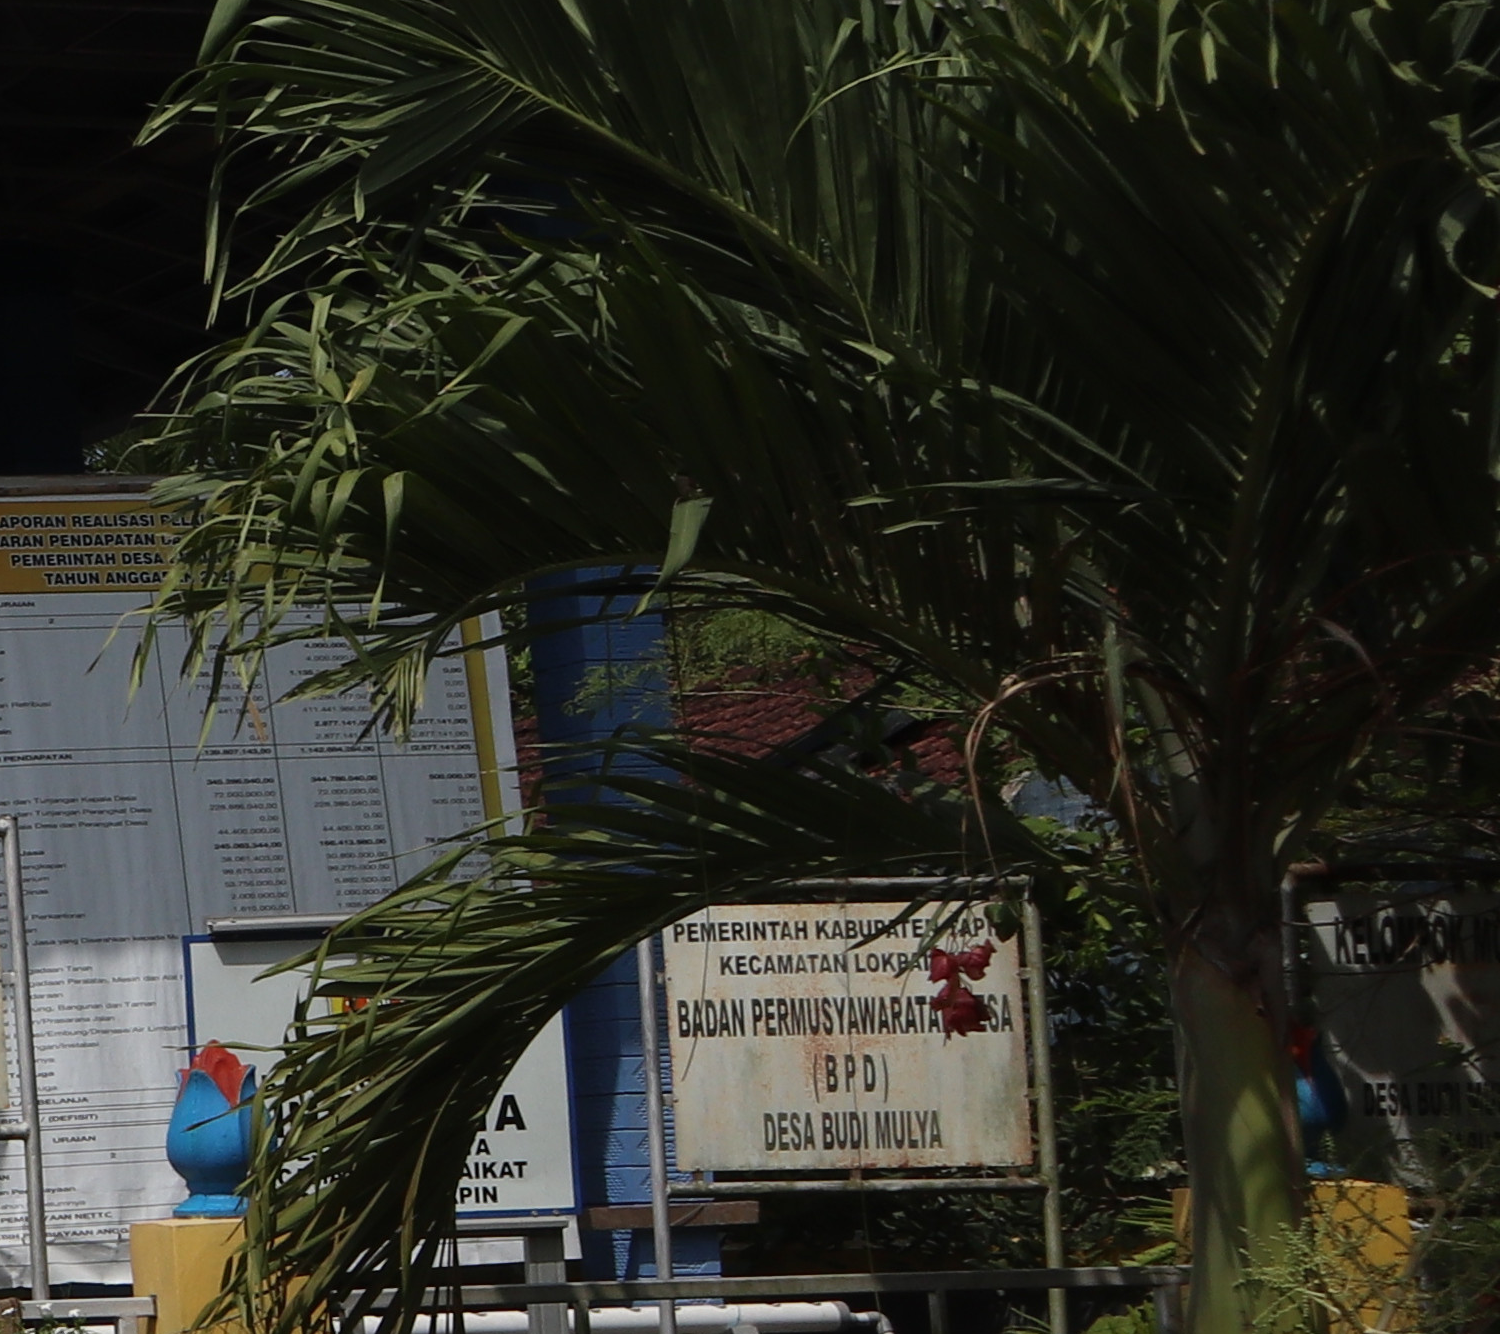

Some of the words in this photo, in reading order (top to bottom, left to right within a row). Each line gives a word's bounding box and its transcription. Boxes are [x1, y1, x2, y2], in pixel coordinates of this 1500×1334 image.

[72, 514, 155, 528] REALISASI
[50, 533, 155, 547] PENDAPATAN
[11, 553, 116, 567] PEMERINTAH
[122, 552, 163, 565] DESA
[44, 572, 99, 585] TAHUN
[673, 921, 808, 943] PEMERINTAH
[720, 954, 847, 976] KECAMATAN
[677, 999, 745, 1038] BADAN
[753, 996, 942, 1038] PERMUSYAWARATA
[764, 1112, 815, 1151] DESA
[822, 1112, 871, 1151] BUDI
[876, 1110, 943, 1149] MULYA
